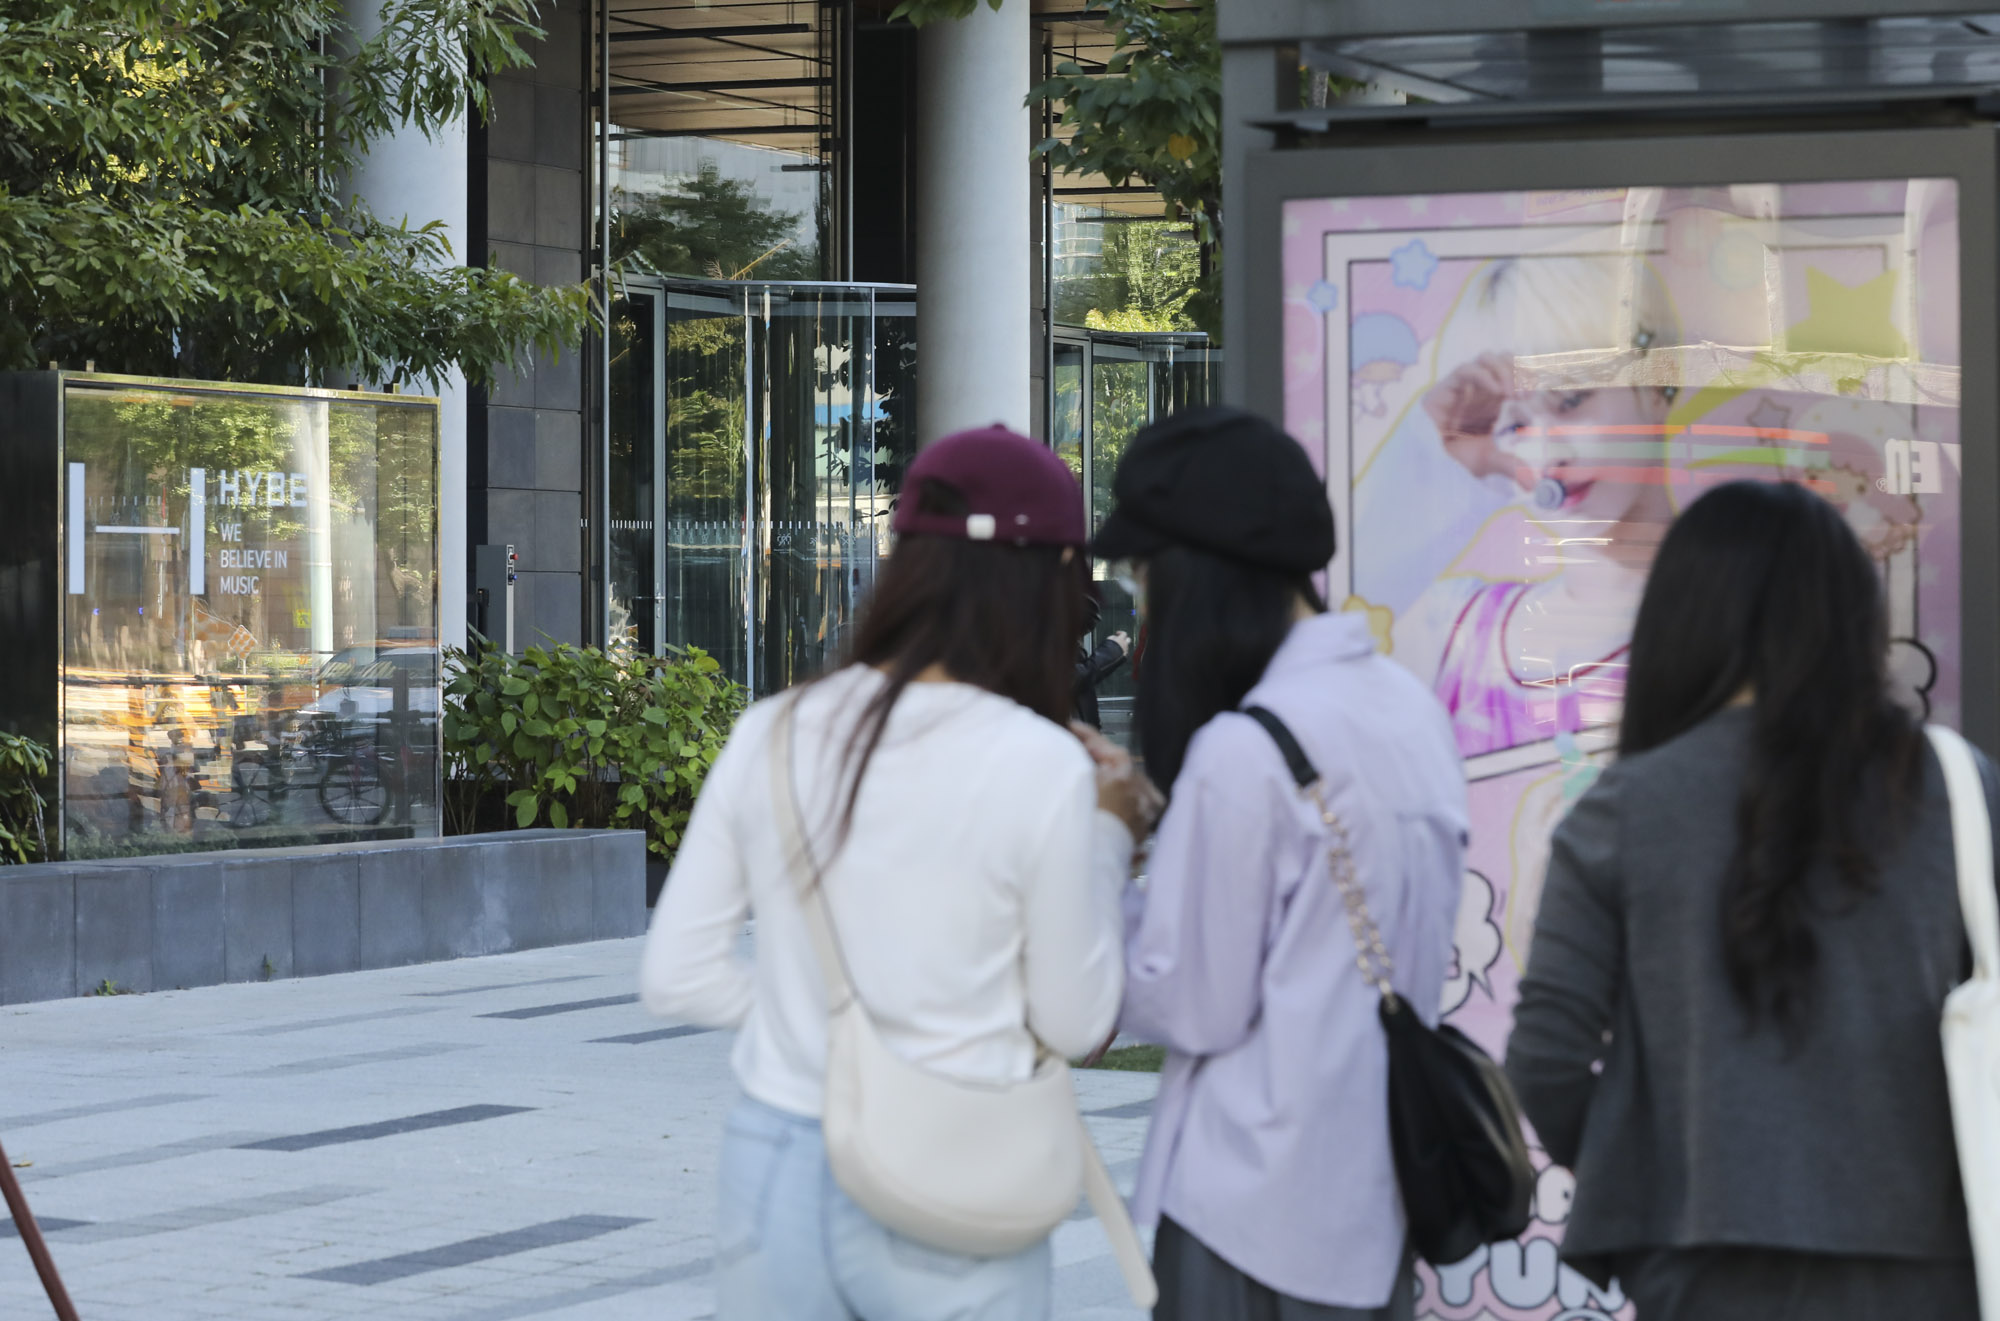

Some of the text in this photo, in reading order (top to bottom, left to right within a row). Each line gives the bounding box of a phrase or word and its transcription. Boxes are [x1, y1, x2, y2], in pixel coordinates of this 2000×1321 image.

[220, 469, 308, 507] HYBE
[220, 523, 242, 542] WE
[220, 550, 288, 569] BELIEVE IN
[220, 576, 260, 595] MUSIC
